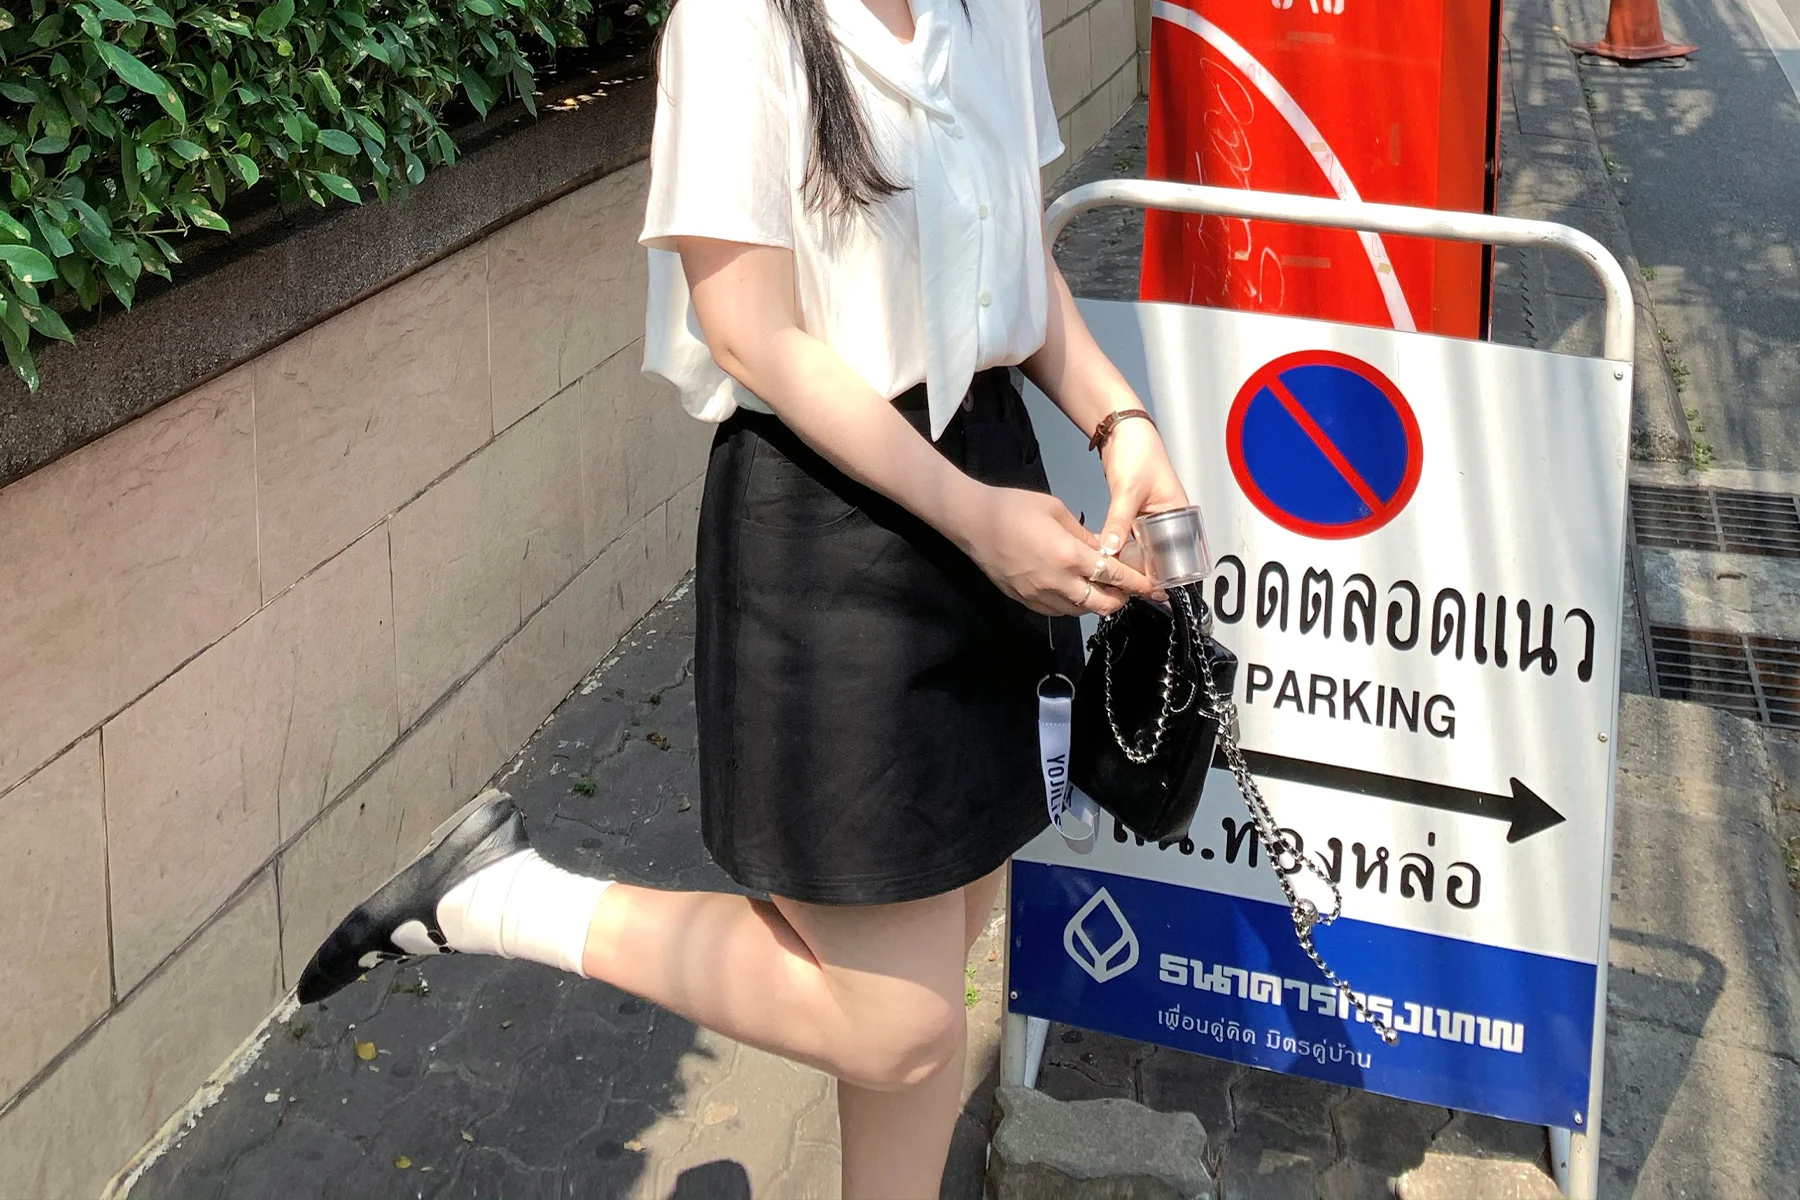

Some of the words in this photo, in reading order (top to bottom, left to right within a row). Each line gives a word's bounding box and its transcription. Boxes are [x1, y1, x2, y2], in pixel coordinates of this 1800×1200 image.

[1213, 553, 1596, 683] อดตลอดแนว
[1245, 663, 1457, 740] PARKING
[1158, 953, 1525, 1055] ธนาคารกรุงเทพ
[1158, 1003, 1257, 1045] เพื่อนคู่คิด
[1266, 1029, 1373, 1069] มิตรคู่บ้าน
